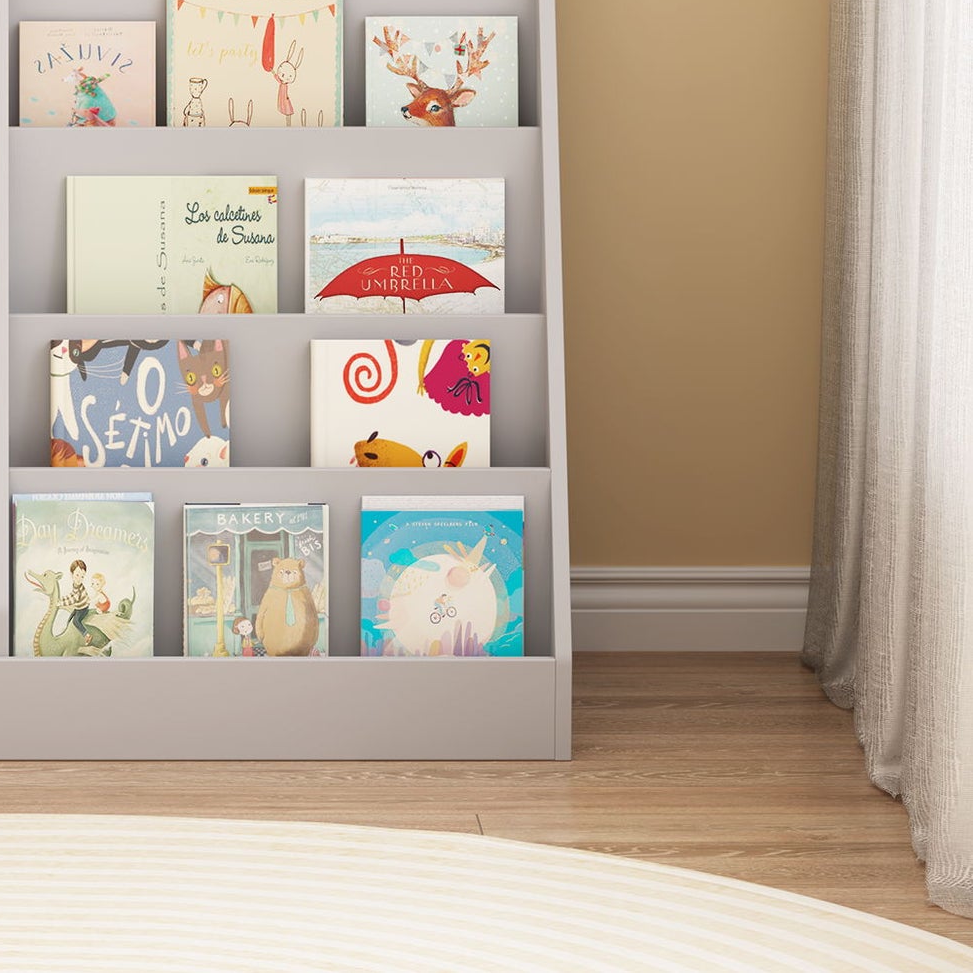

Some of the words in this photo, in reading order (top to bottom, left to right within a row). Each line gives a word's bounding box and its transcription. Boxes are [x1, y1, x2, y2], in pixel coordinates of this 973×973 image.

[218, 41, 259, 65] party
[184, 201, 211, 225] Los
[214, 203, 263, 223] calcetines
[216, 226, 230, 244] de
[231, 225, 276, 245] Susana
[398, 256, 413, 265] THE
[389, 264, 424, 278] RED
[360, 277, 454, 293] UMBRELLA
[136, 356, 166, 416] O
[216, 512, 286, 526] BAKERY
